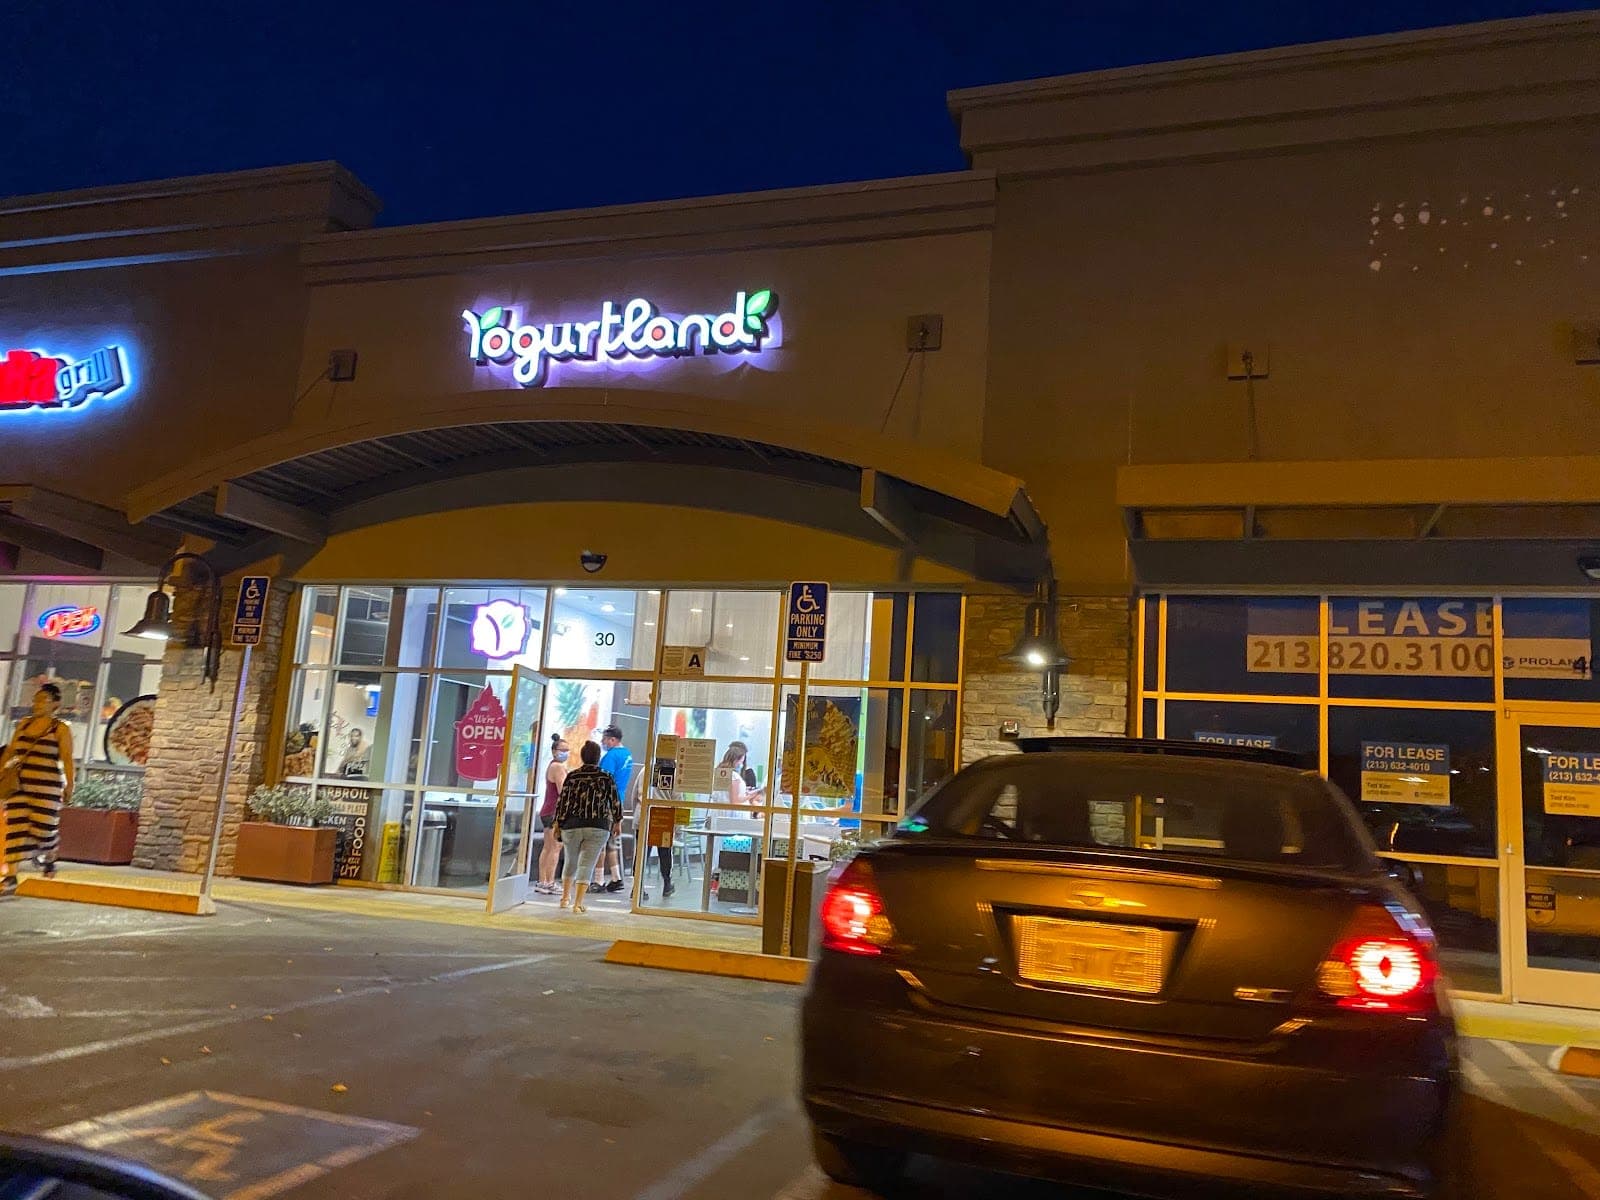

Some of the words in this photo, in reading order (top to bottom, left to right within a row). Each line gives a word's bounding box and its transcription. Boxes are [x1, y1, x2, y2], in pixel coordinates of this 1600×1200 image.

[461, 290, 754, 383] Yogurtland
[59, 350, 110, 397] grill
[44, 607, 97, 638] OPEN
[790, 613, 825, 625] PARKING
[1327, 601, 1505, 636] LEASE
[594, 632, 615, 646] 30
[796, 626, 818, 638] ONLY
[793, 641, 819, 650] MINIMUM
[688, 654, 701, 668] A
[1253, 640, 1494, 672] 213.820.3100
[1519, 657, 1582, 667] PROLAN
[1573, 656, 1588, 676] 4
[473, 713, 496, 724] We're
[462, 724, 506, 741] OPEN
[1365, 746, 1395, 759] FOR
[1398, 747, 1445, 761] LEASE
[1366, 760, 1388, 771] (213)
[1547, 756, 1579, 769] FOR
[1583, 757, 1600, 770] LE
[1549, 771, 1573, 782] (213)
[1575, 772, 1600, 782] 632-
[351, 816, 366, 857] FOOD
